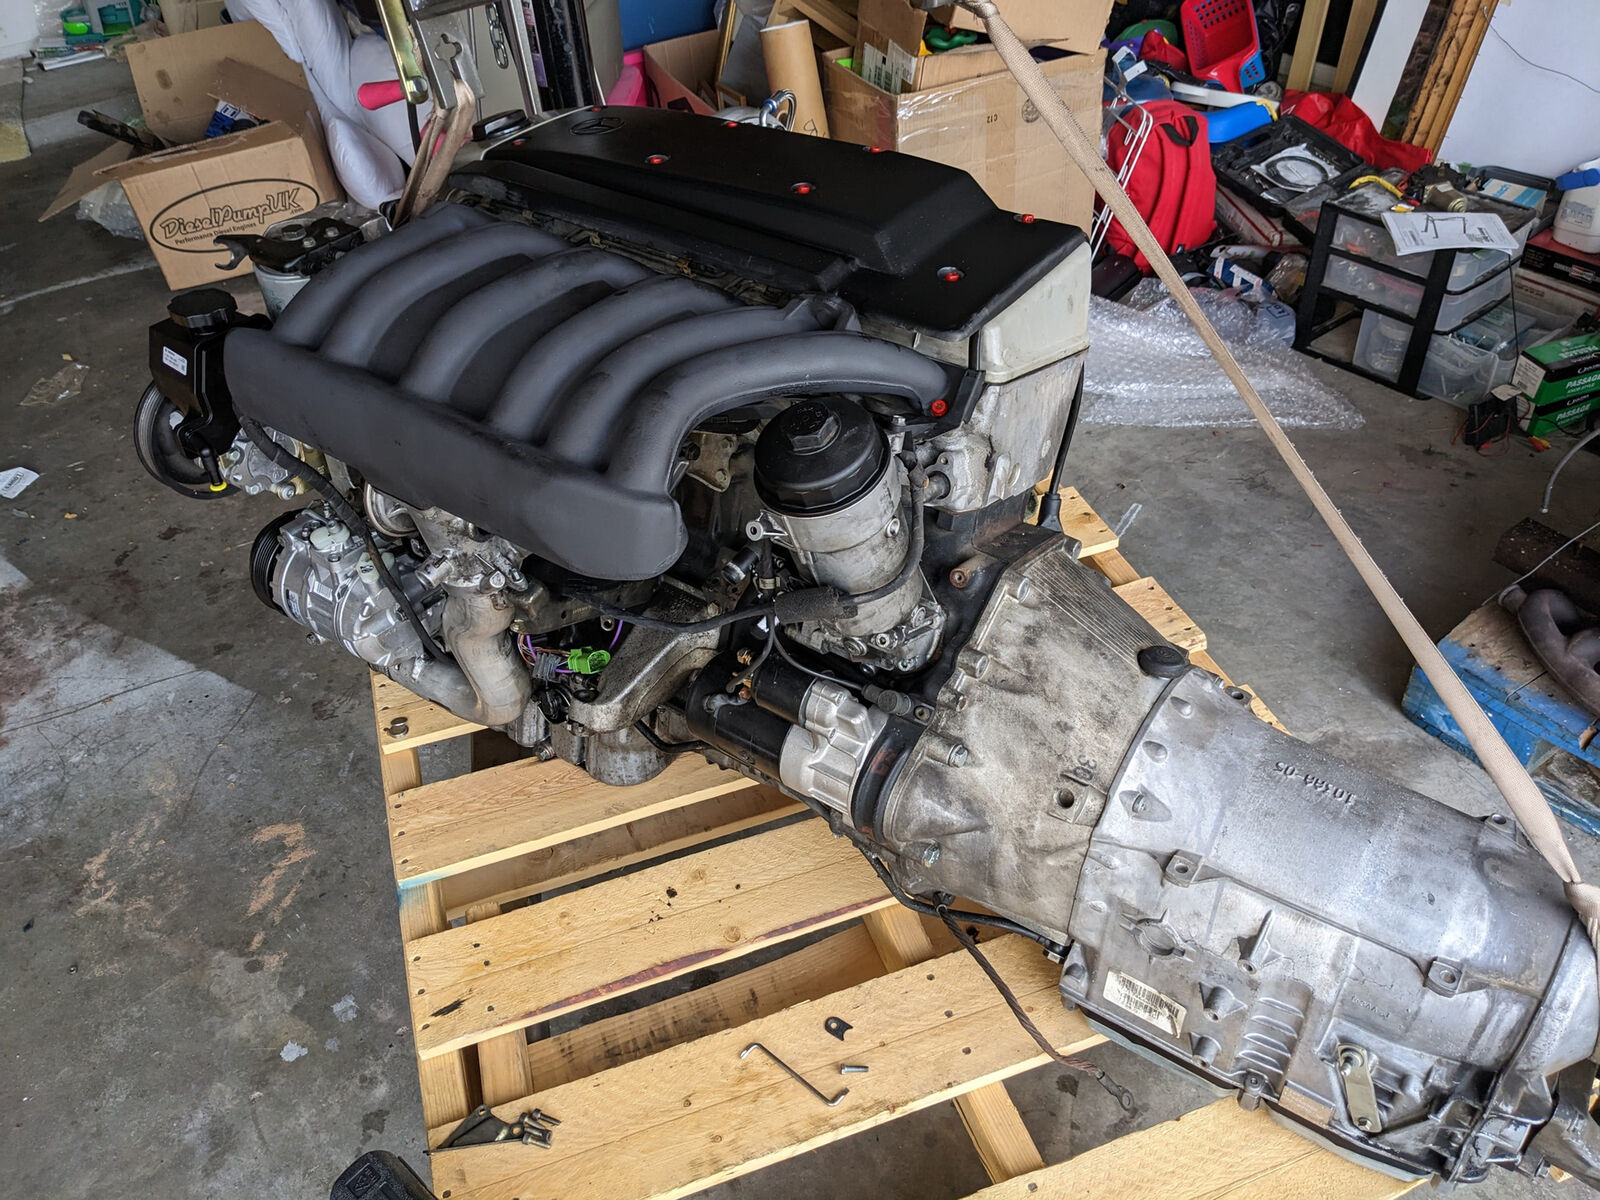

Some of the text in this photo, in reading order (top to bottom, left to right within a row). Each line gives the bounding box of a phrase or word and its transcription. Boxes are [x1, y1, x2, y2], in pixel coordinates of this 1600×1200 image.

[160, 187, 302, 240] DieselPumpUK
[174, 222, 257, 246] Performance Diesel Engines
